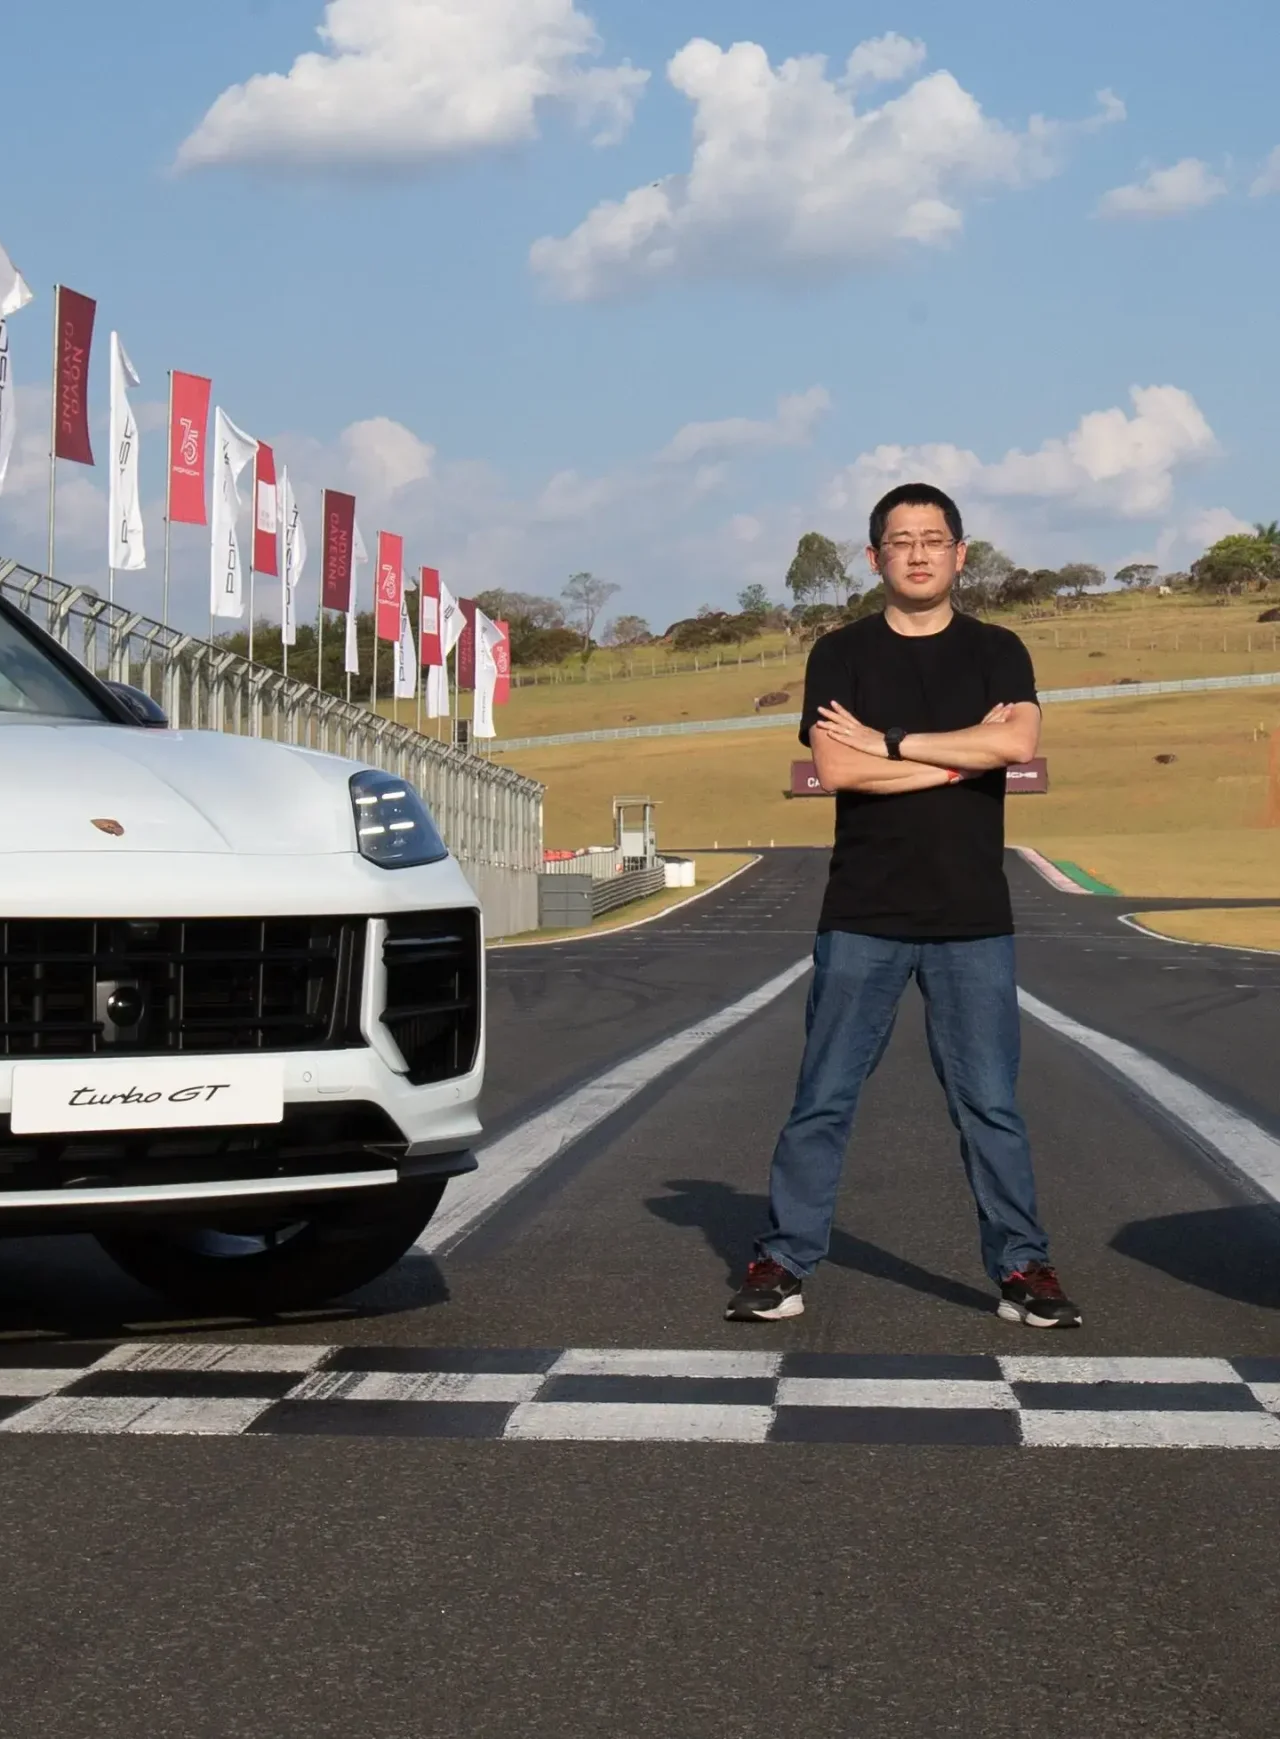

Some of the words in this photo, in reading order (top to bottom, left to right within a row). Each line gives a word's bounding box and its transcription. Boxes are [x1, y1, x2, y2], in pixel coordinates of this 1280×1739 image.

[71, 346, 84, 415] NOVO
[336, 529, 348, 578] NOVO
[68, 1085, 162, 1106] turbo
[168, 1084, 231, 1102] GT
